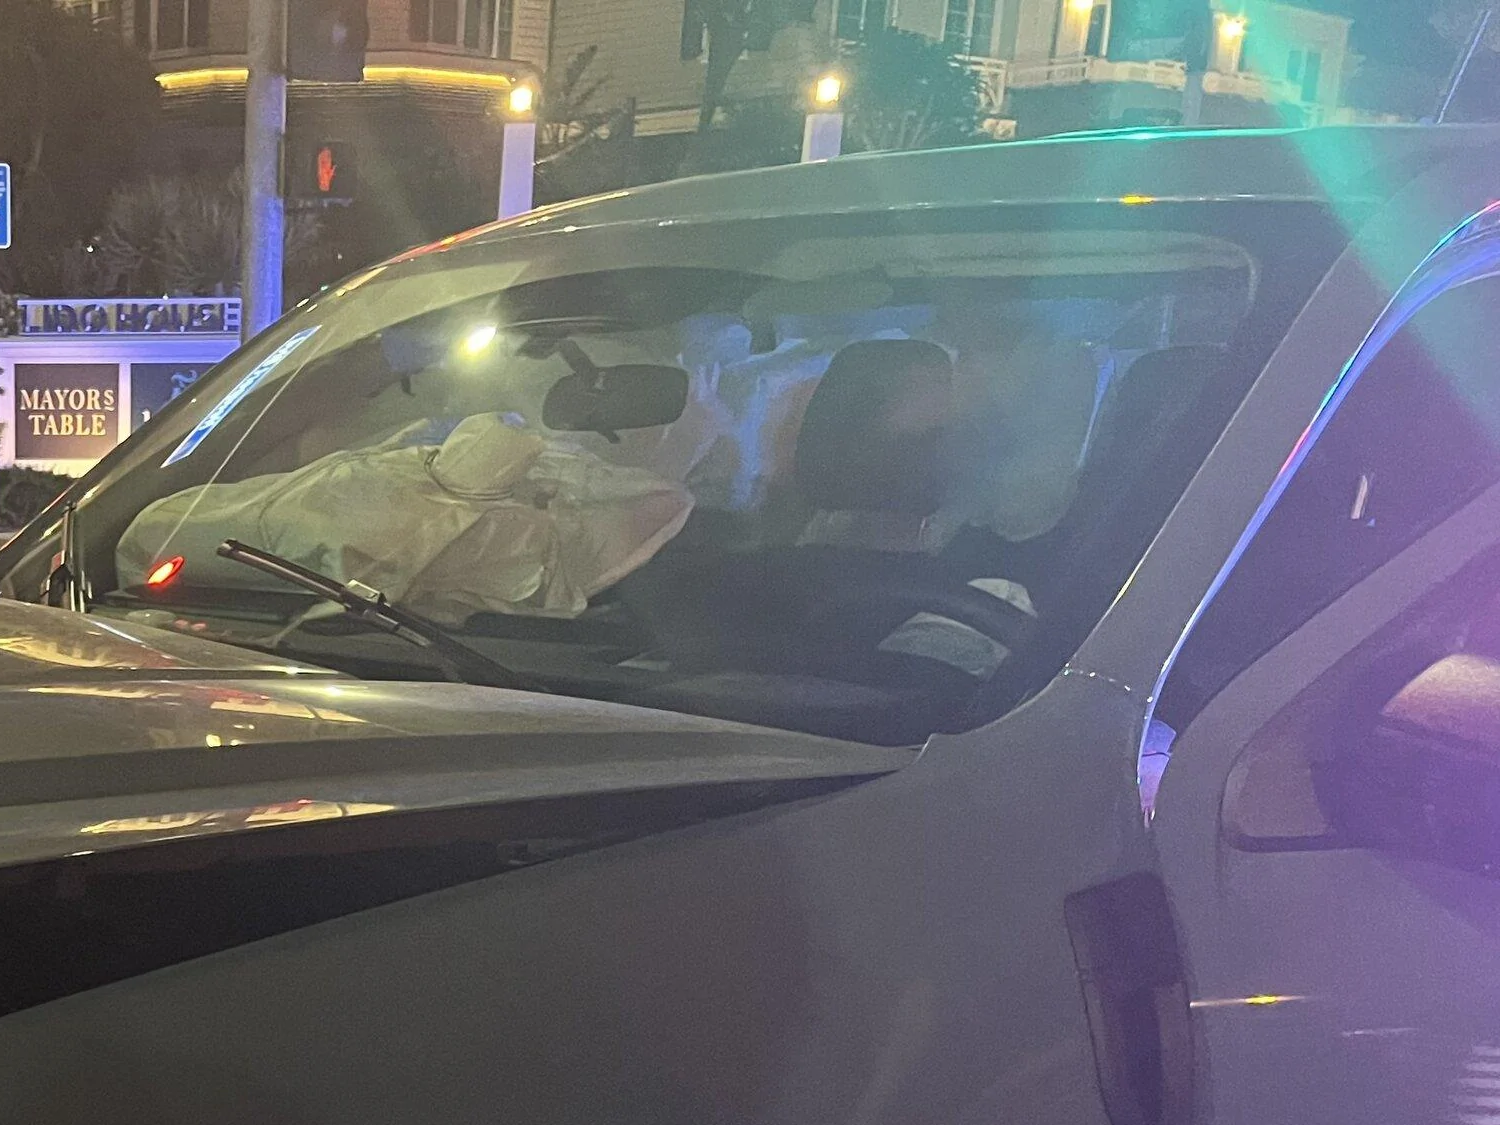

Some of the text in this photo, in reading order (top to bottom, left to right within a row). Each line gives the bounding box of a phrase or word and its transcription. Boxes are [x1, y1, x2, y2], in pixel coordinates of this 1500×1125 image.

[21, 303, 241, 333] LIDO HOUSE
[28, 414, 106, 436] TABLE
